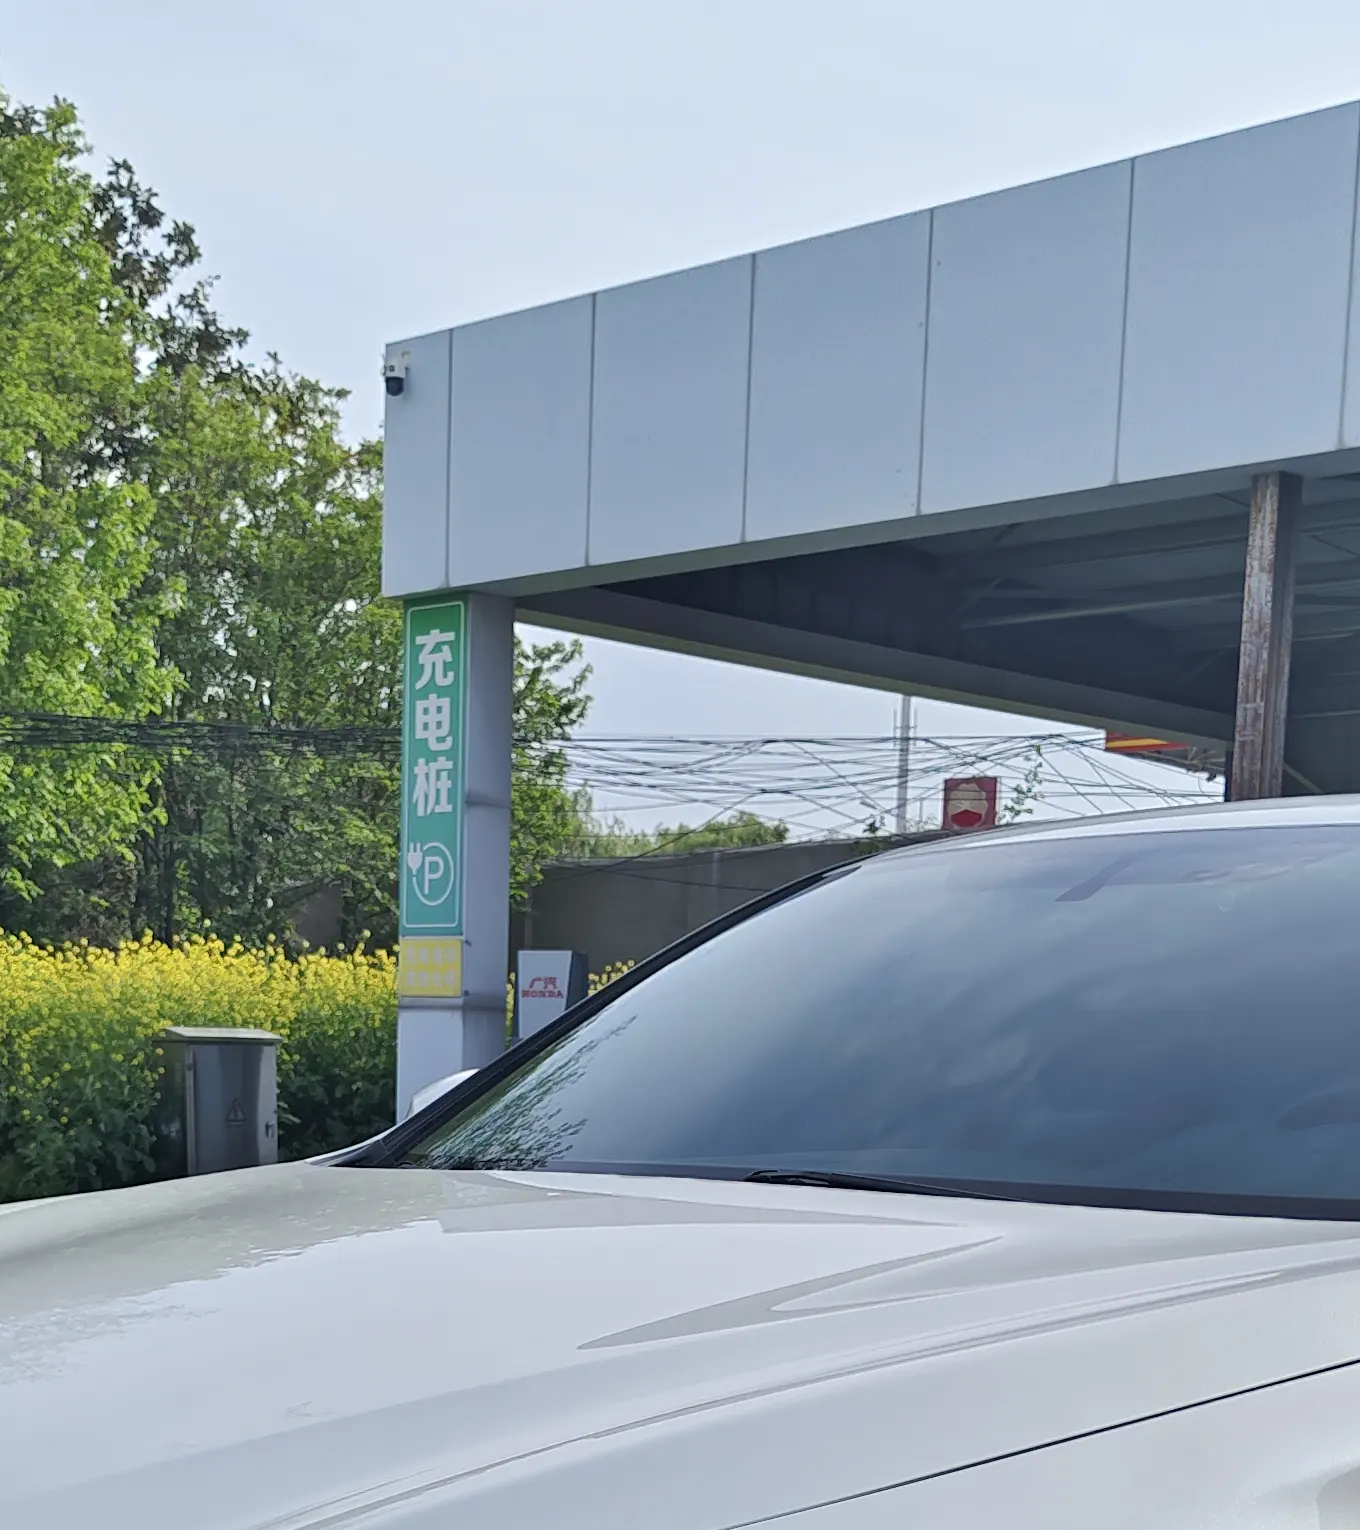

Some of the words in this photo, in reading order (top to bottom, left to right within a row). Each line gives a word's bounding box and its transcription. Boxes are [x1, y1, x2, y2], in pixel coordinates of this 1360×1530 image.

[413, 629, 455, 817] 充电桩
[521, 989, 565, 999] HONDA
